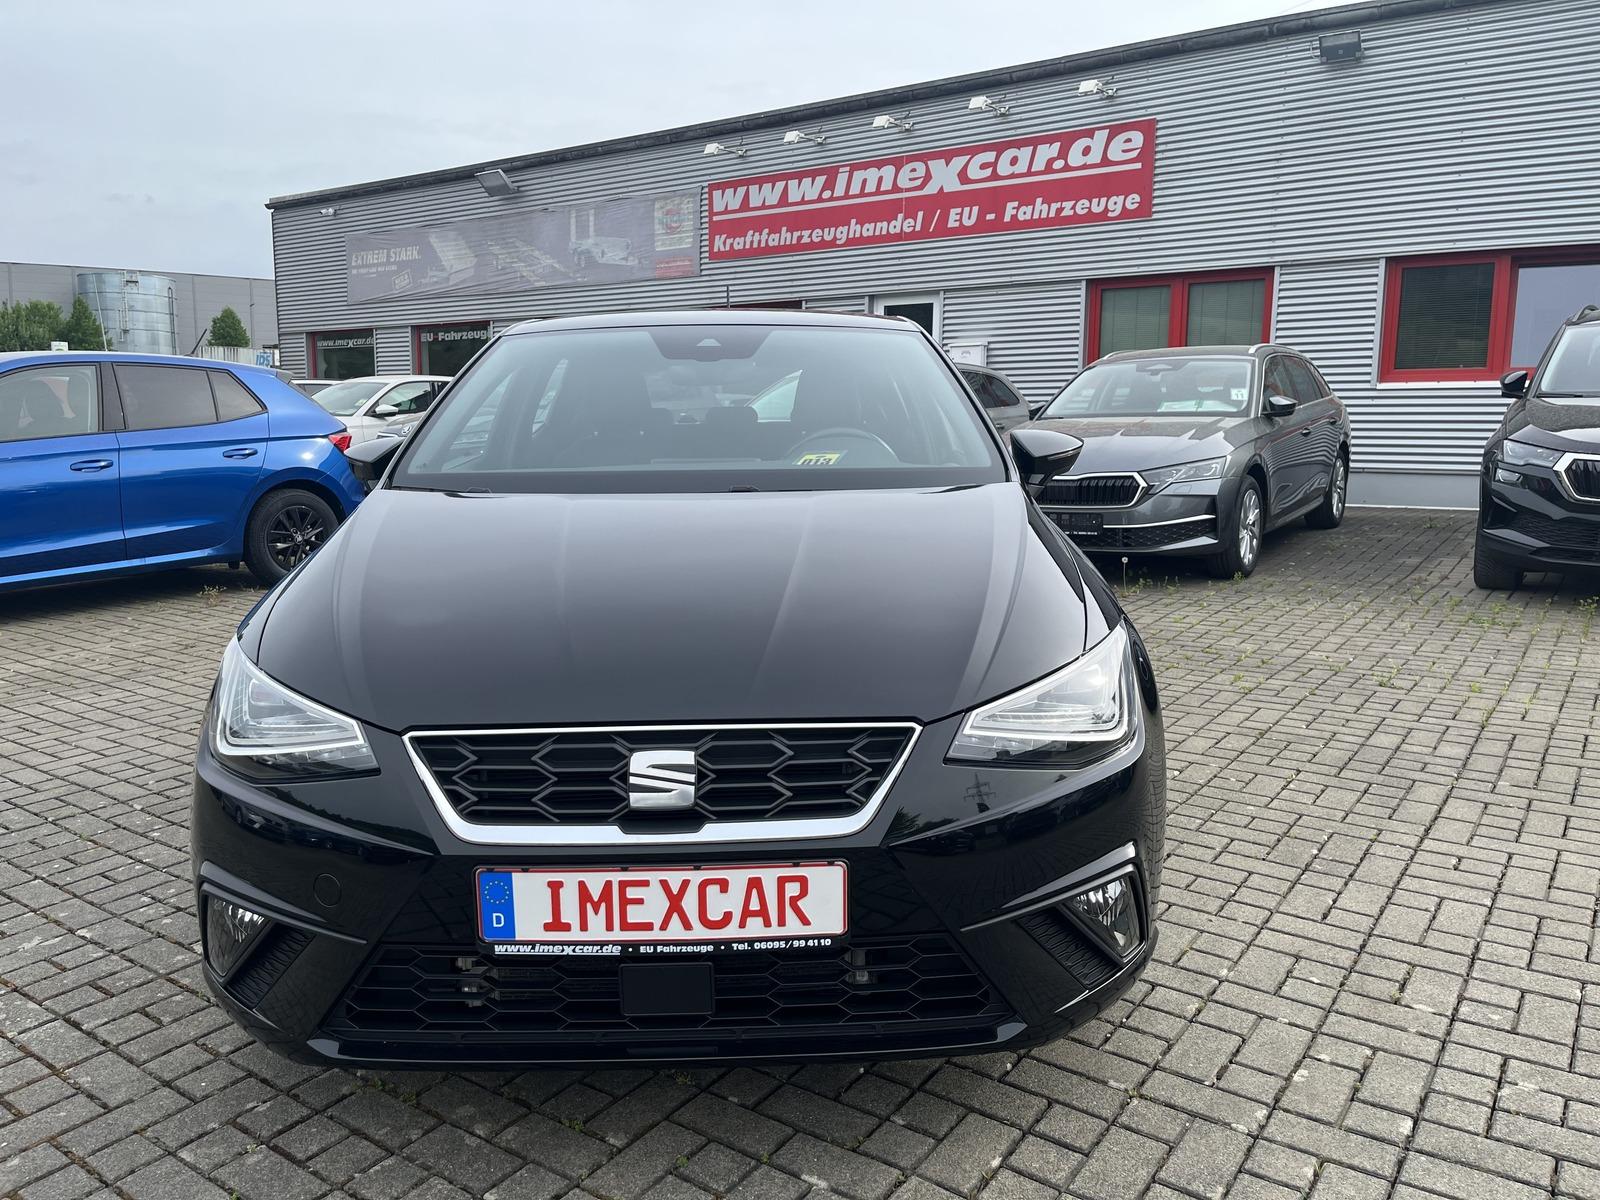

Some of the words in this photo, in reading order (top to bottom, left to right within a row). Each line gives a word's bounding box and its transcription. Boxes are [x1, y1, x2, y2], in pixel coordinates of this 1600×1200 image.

[712, 129, 1144, 213] www.imexcar.de
[714, 211, 924, 252] Kraftfahrzeughandel
[929, 209, 941, 232] /
[947, 206, 979, 228] EU
[1003, 193, 1141, 222] Fahrzeuge
[351, 249, 387, 266] EXTREM
[493, 913, 504, 927] D
[543, 875, 811, 932] IMEXCAR
[494, 944, 622, 956] www.imexcar.de
[639, 945, 653, 953] EU
[657, 943, 714, 953] Fahrzeuge
[732, 942, 751, 951] Tel.
